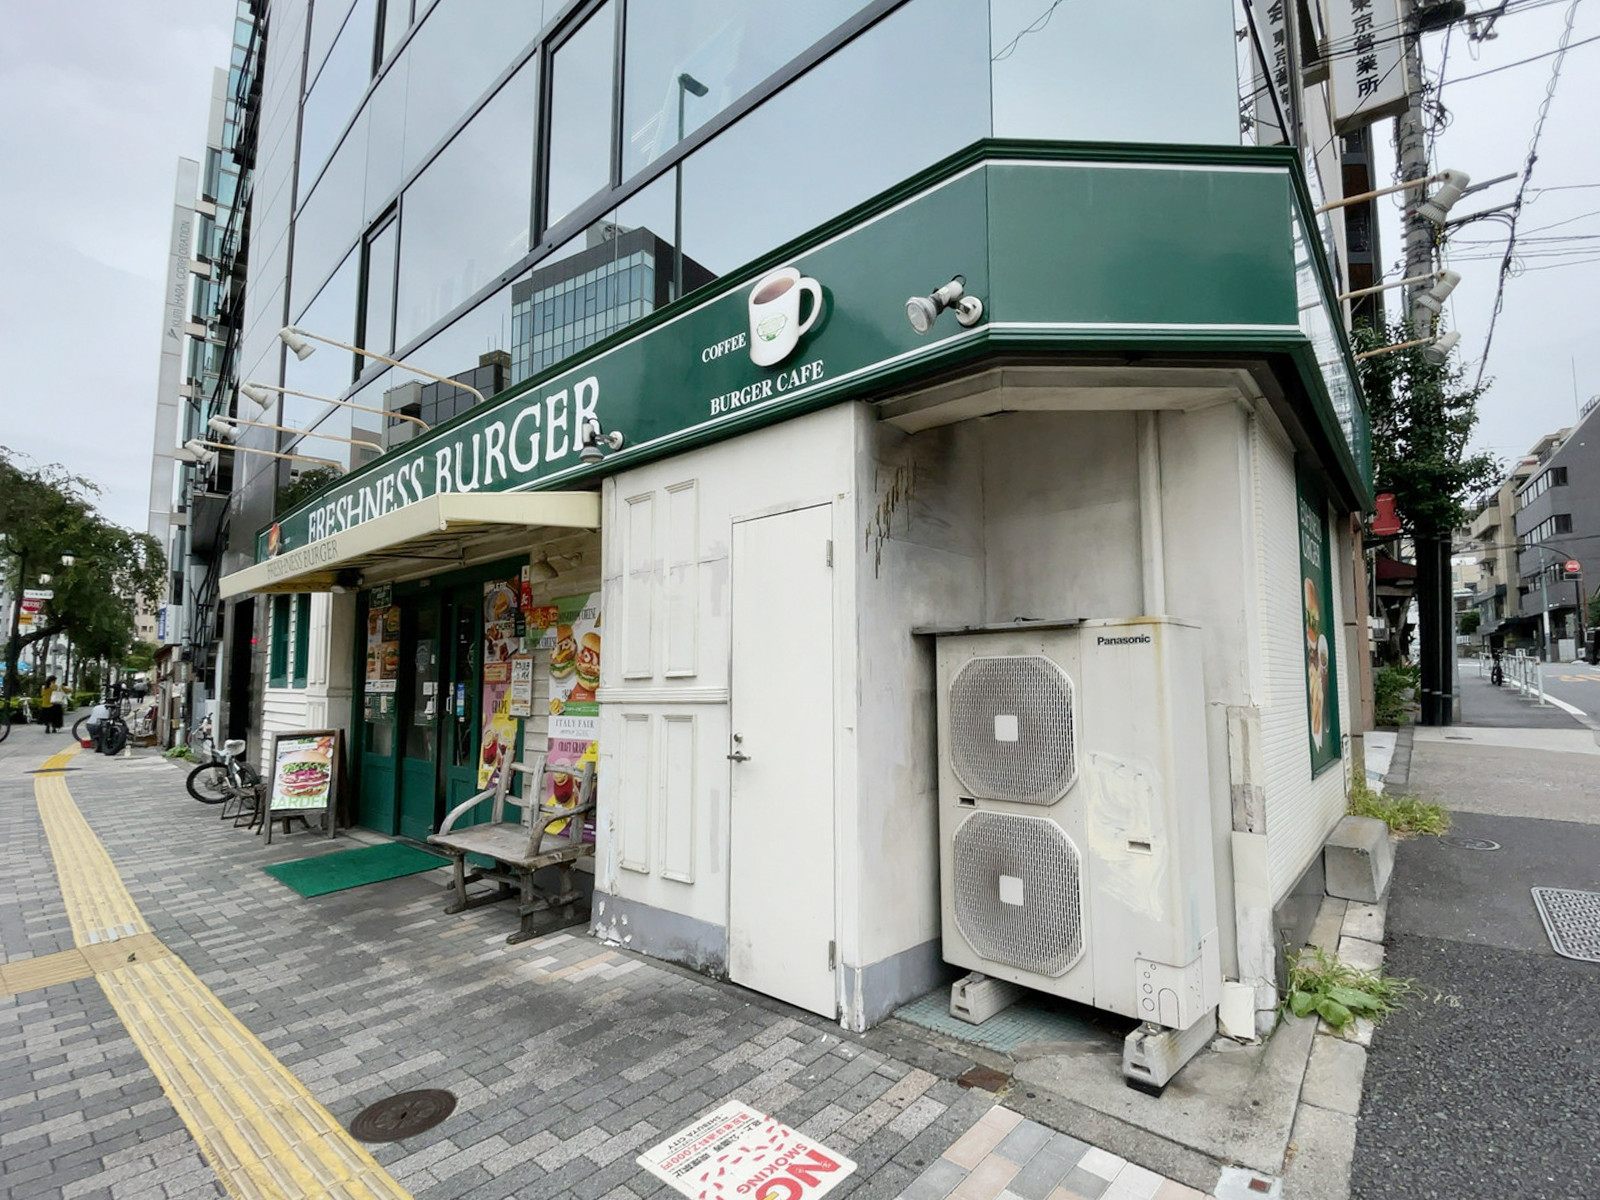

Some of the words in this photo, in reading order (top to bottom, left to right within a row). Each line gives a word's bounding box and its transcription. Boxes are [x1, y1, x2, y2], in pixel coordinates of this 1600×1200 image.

[701, 332, 746, 363] COFFEE
[709, 379, 773, 416] BURGER
[776, 360, 824, 392] CAFE
[307, 456, 424, 545] FRESHNESS
[435, 376, 600, 495] BURGER
[303, 540, 338, 568] BURGER
[1097, 634, 1151, 646] Panasonic
[668, 1136, 687, 1150] CITY
[736, 1143, 808, 1194] SMOKING
